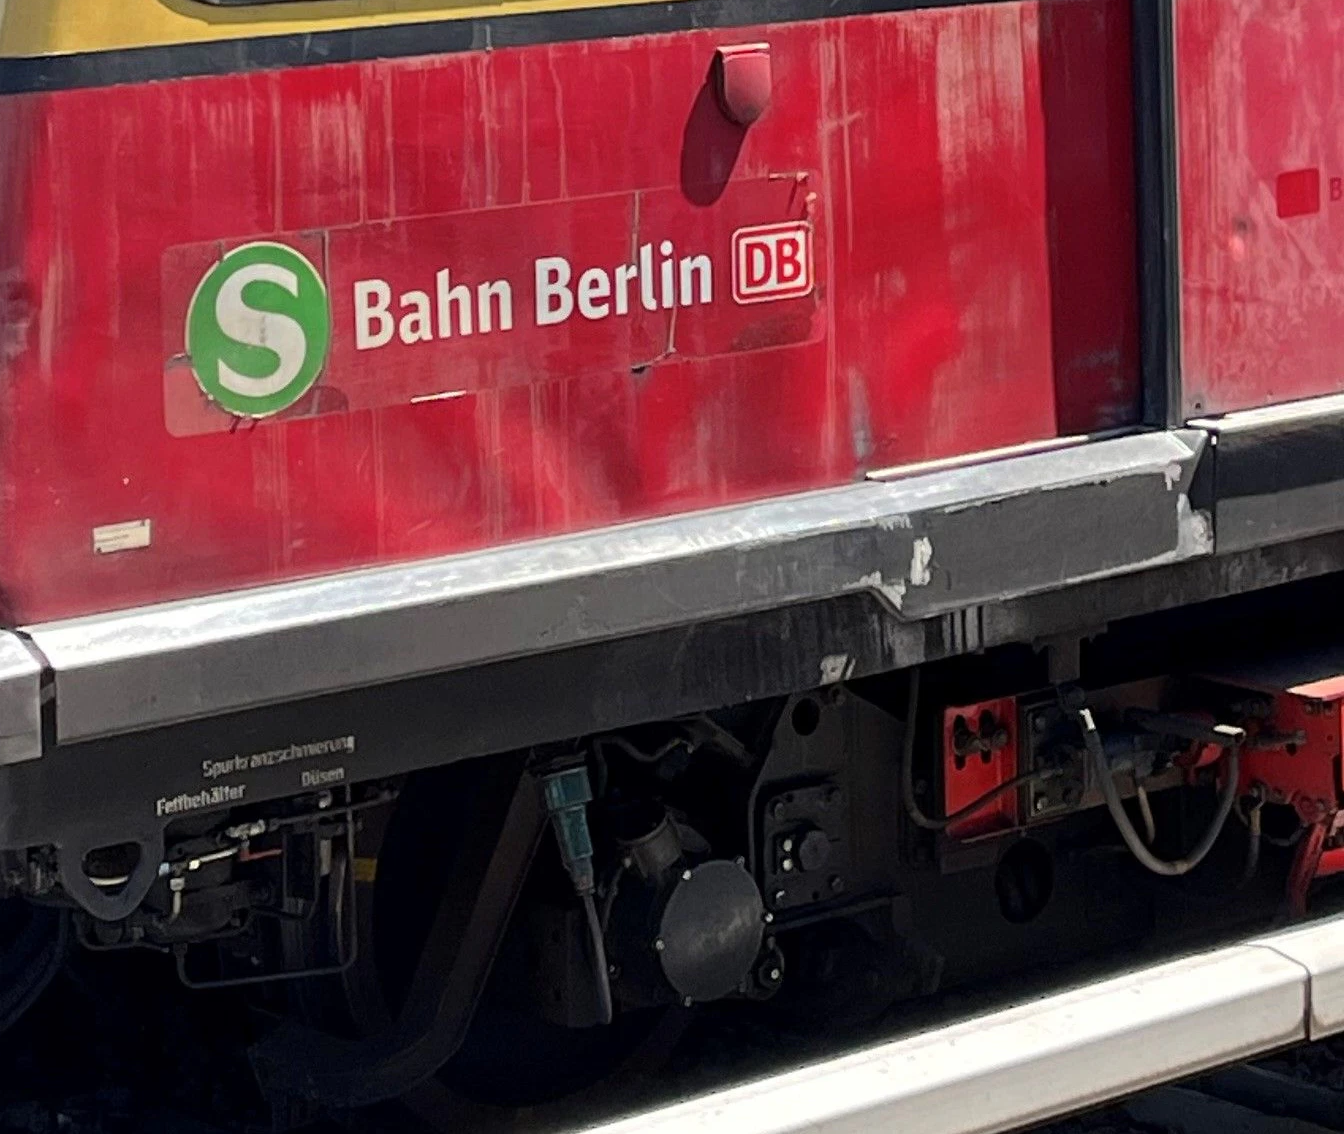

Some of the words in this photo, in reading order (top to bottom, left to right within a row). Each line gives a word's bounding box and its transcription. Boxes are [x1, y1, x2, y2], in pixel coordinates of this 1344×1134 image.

[214, 263, 308, 398] S
[353, 267, 513, 352] Bahn
[533, 240, 714, 327] Berlin
[743, 236, 803, 285] DB
[202, 735, 356, 779] Spurkranzschmierung
[301, 766, 345, 788] Düsen
[156, 783, 247, 817] Fettbehälter
